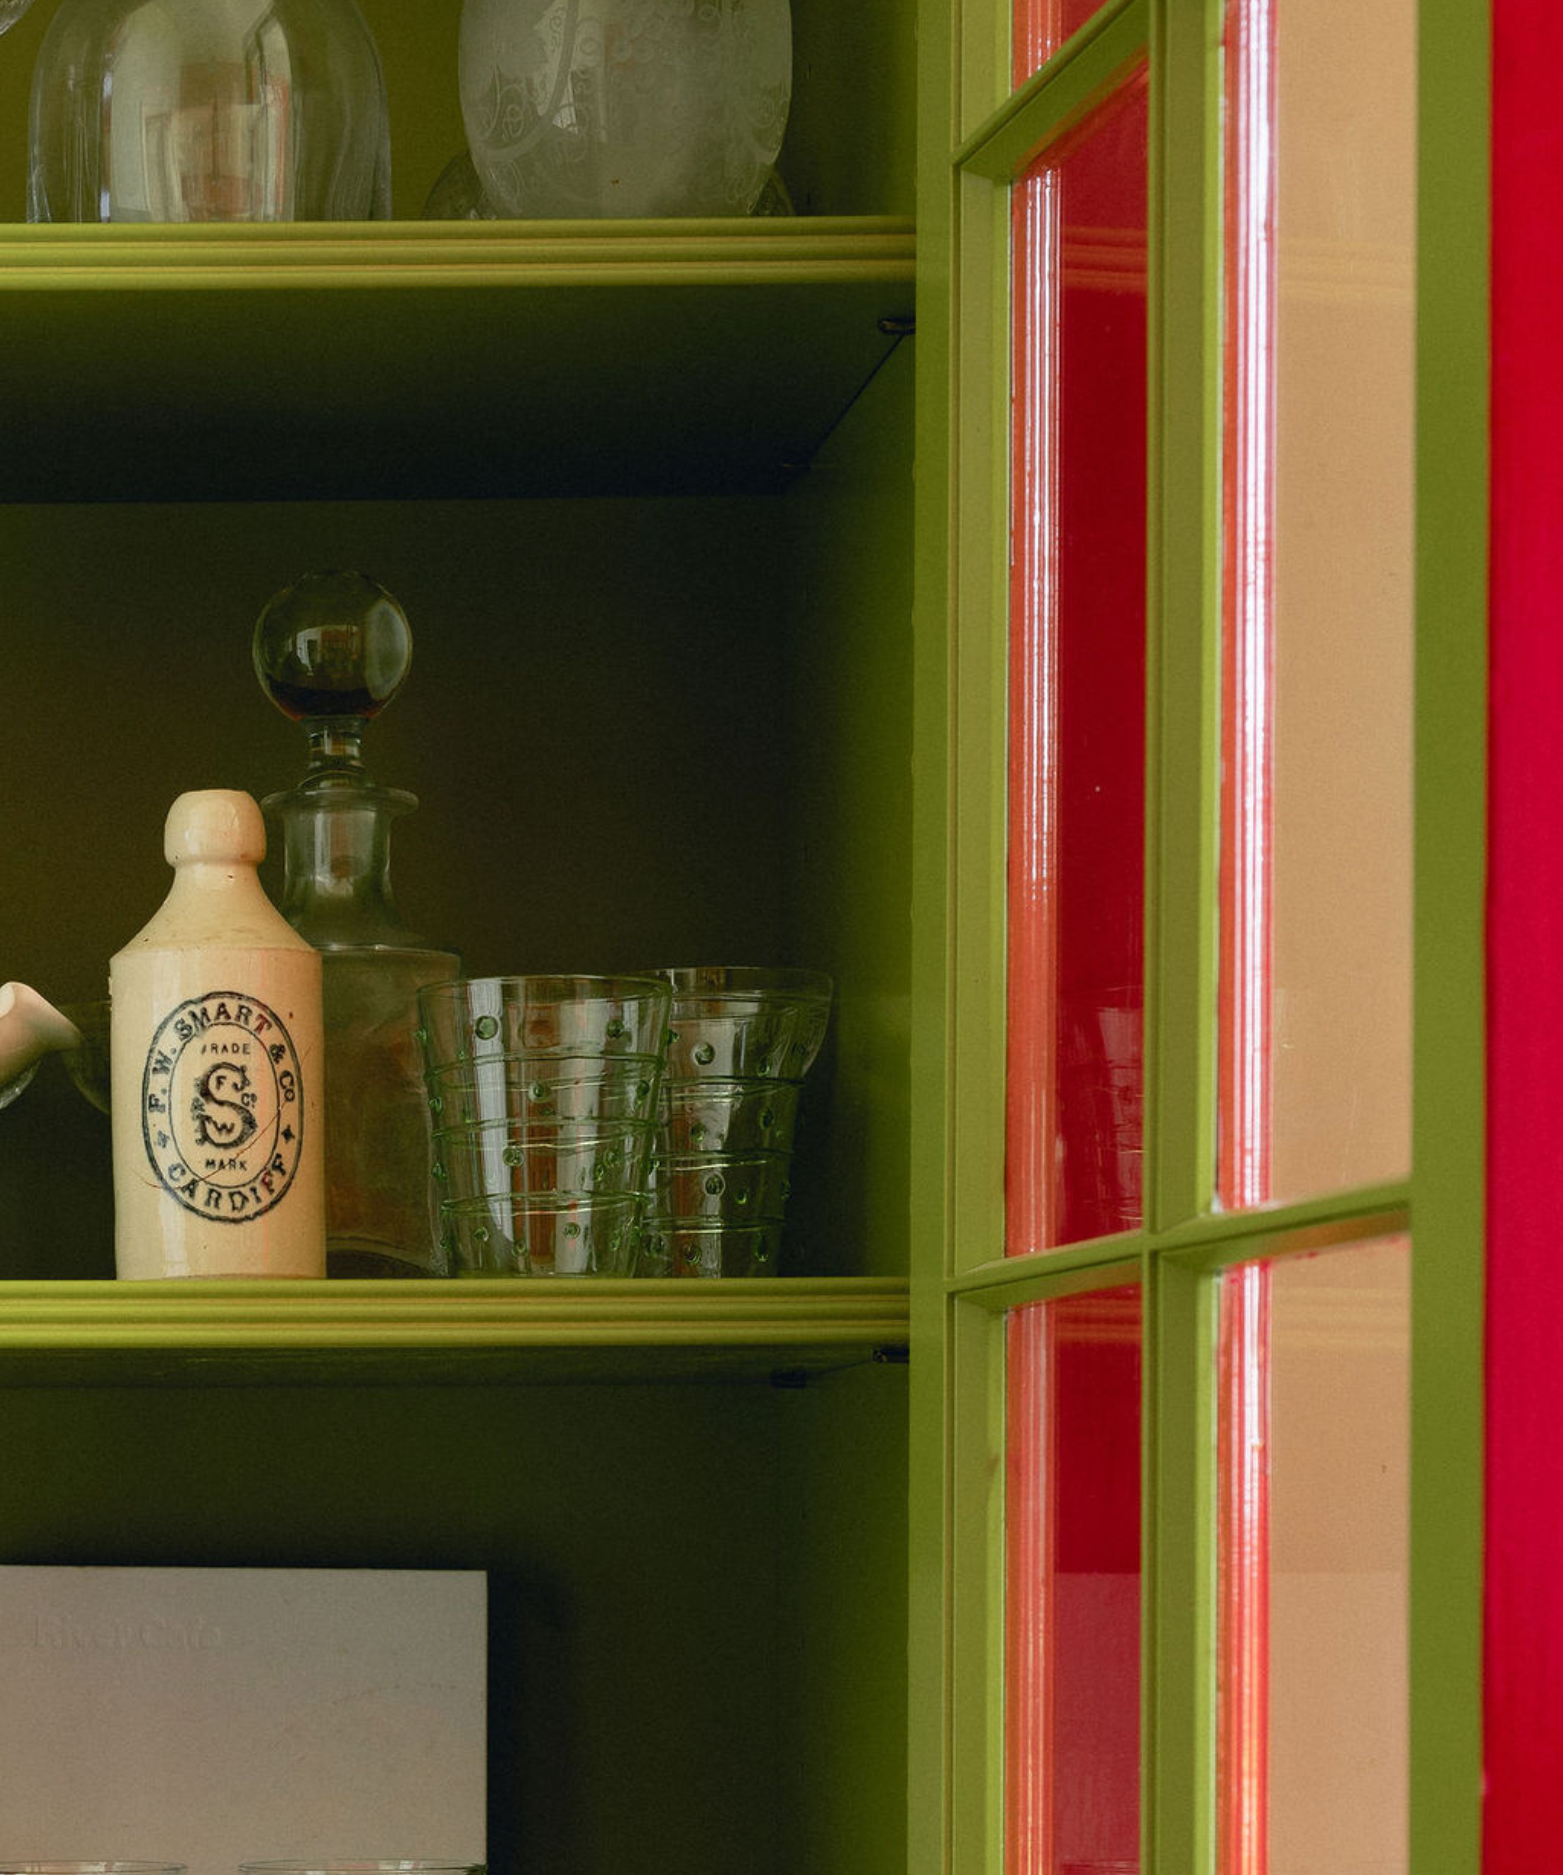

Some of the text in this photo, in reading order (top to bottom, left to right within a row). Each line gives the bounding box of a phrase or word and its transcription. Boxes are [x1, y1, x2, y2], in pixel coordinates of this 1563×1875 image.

[174, 1002, 273, 1042] SMART
[269, 1043, 287, 1064] &
[168, 1153, 287, 1212] CARDIFF
[204, 1158, 248, 1171] MARK
